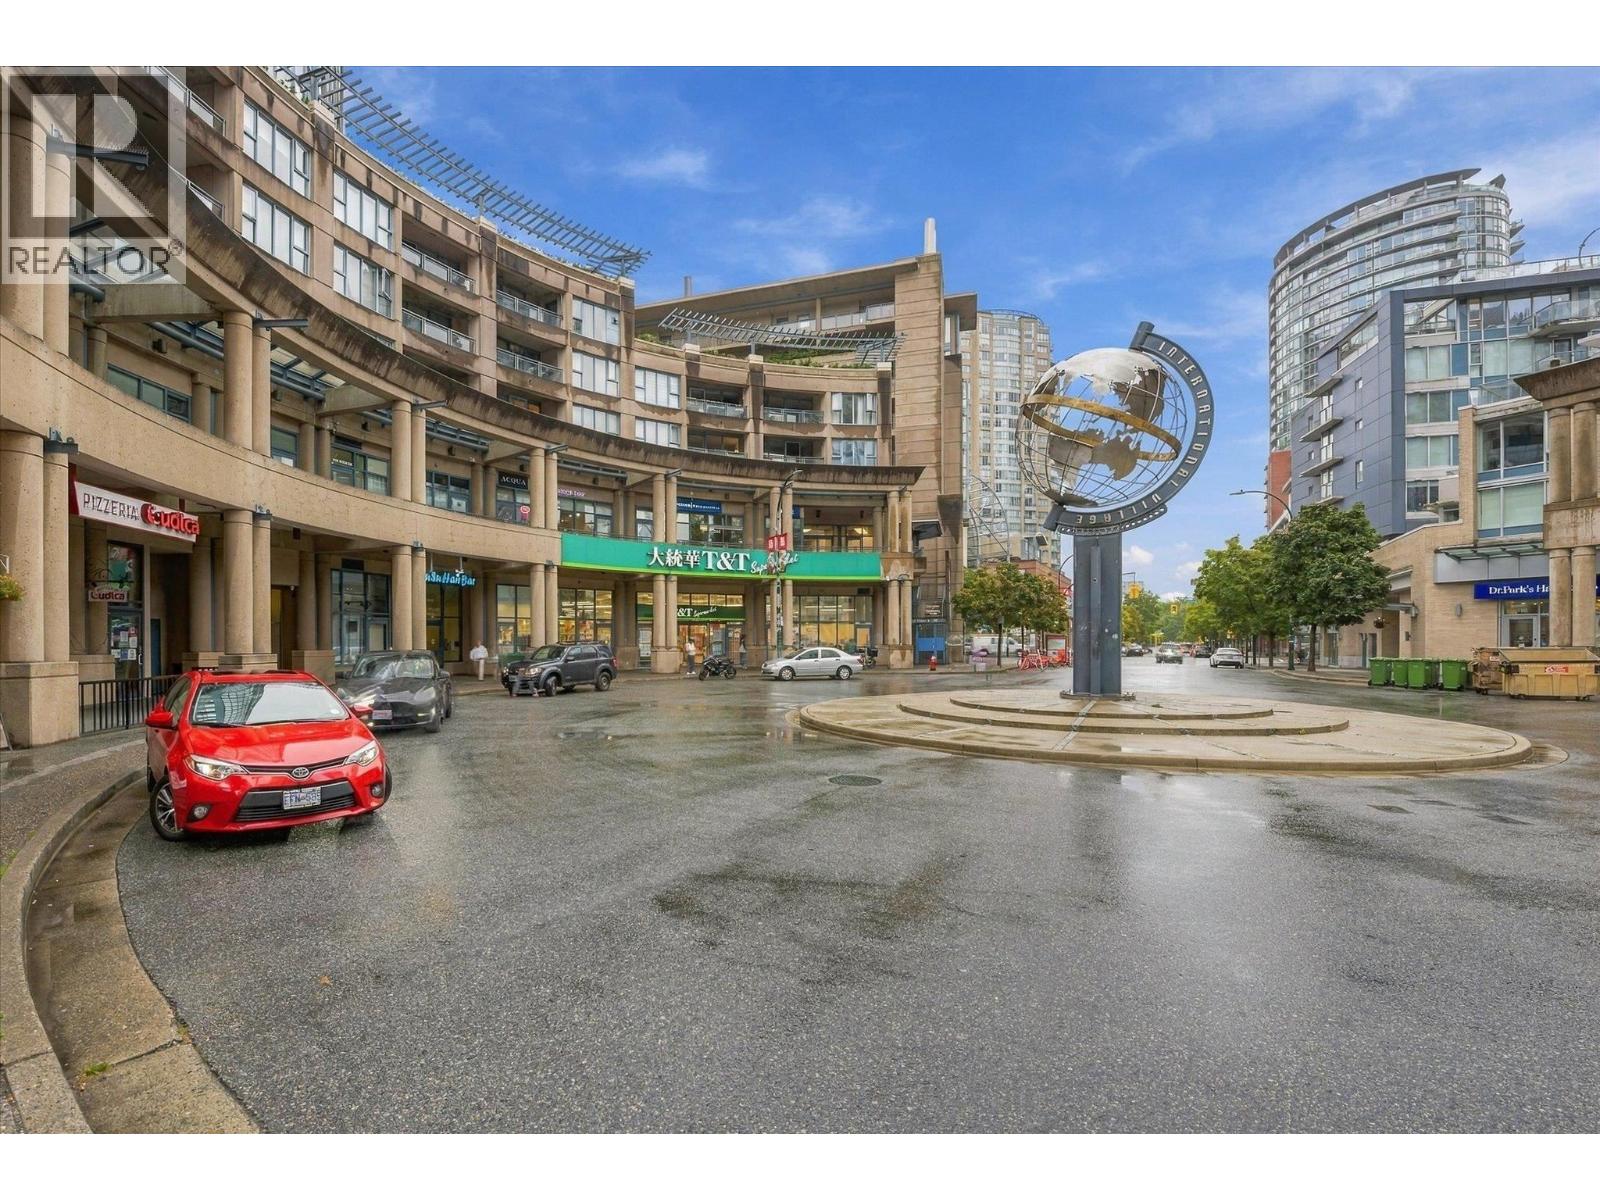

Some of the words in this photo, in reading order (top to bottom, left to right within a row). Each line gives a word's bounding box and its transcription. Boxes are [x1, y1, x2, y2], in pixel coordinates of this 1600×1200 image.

[1158, 341, 1211, 487] INTERNATIONAL
[502, 476, 527, 486] ACQUA
[83, 493, 139, 520] PIZZERIA
[1075, 493, 1162, 524] VILLAGE
[648, 546, 700, 569] 大統華
[702, 551, 750, 571] T&T
